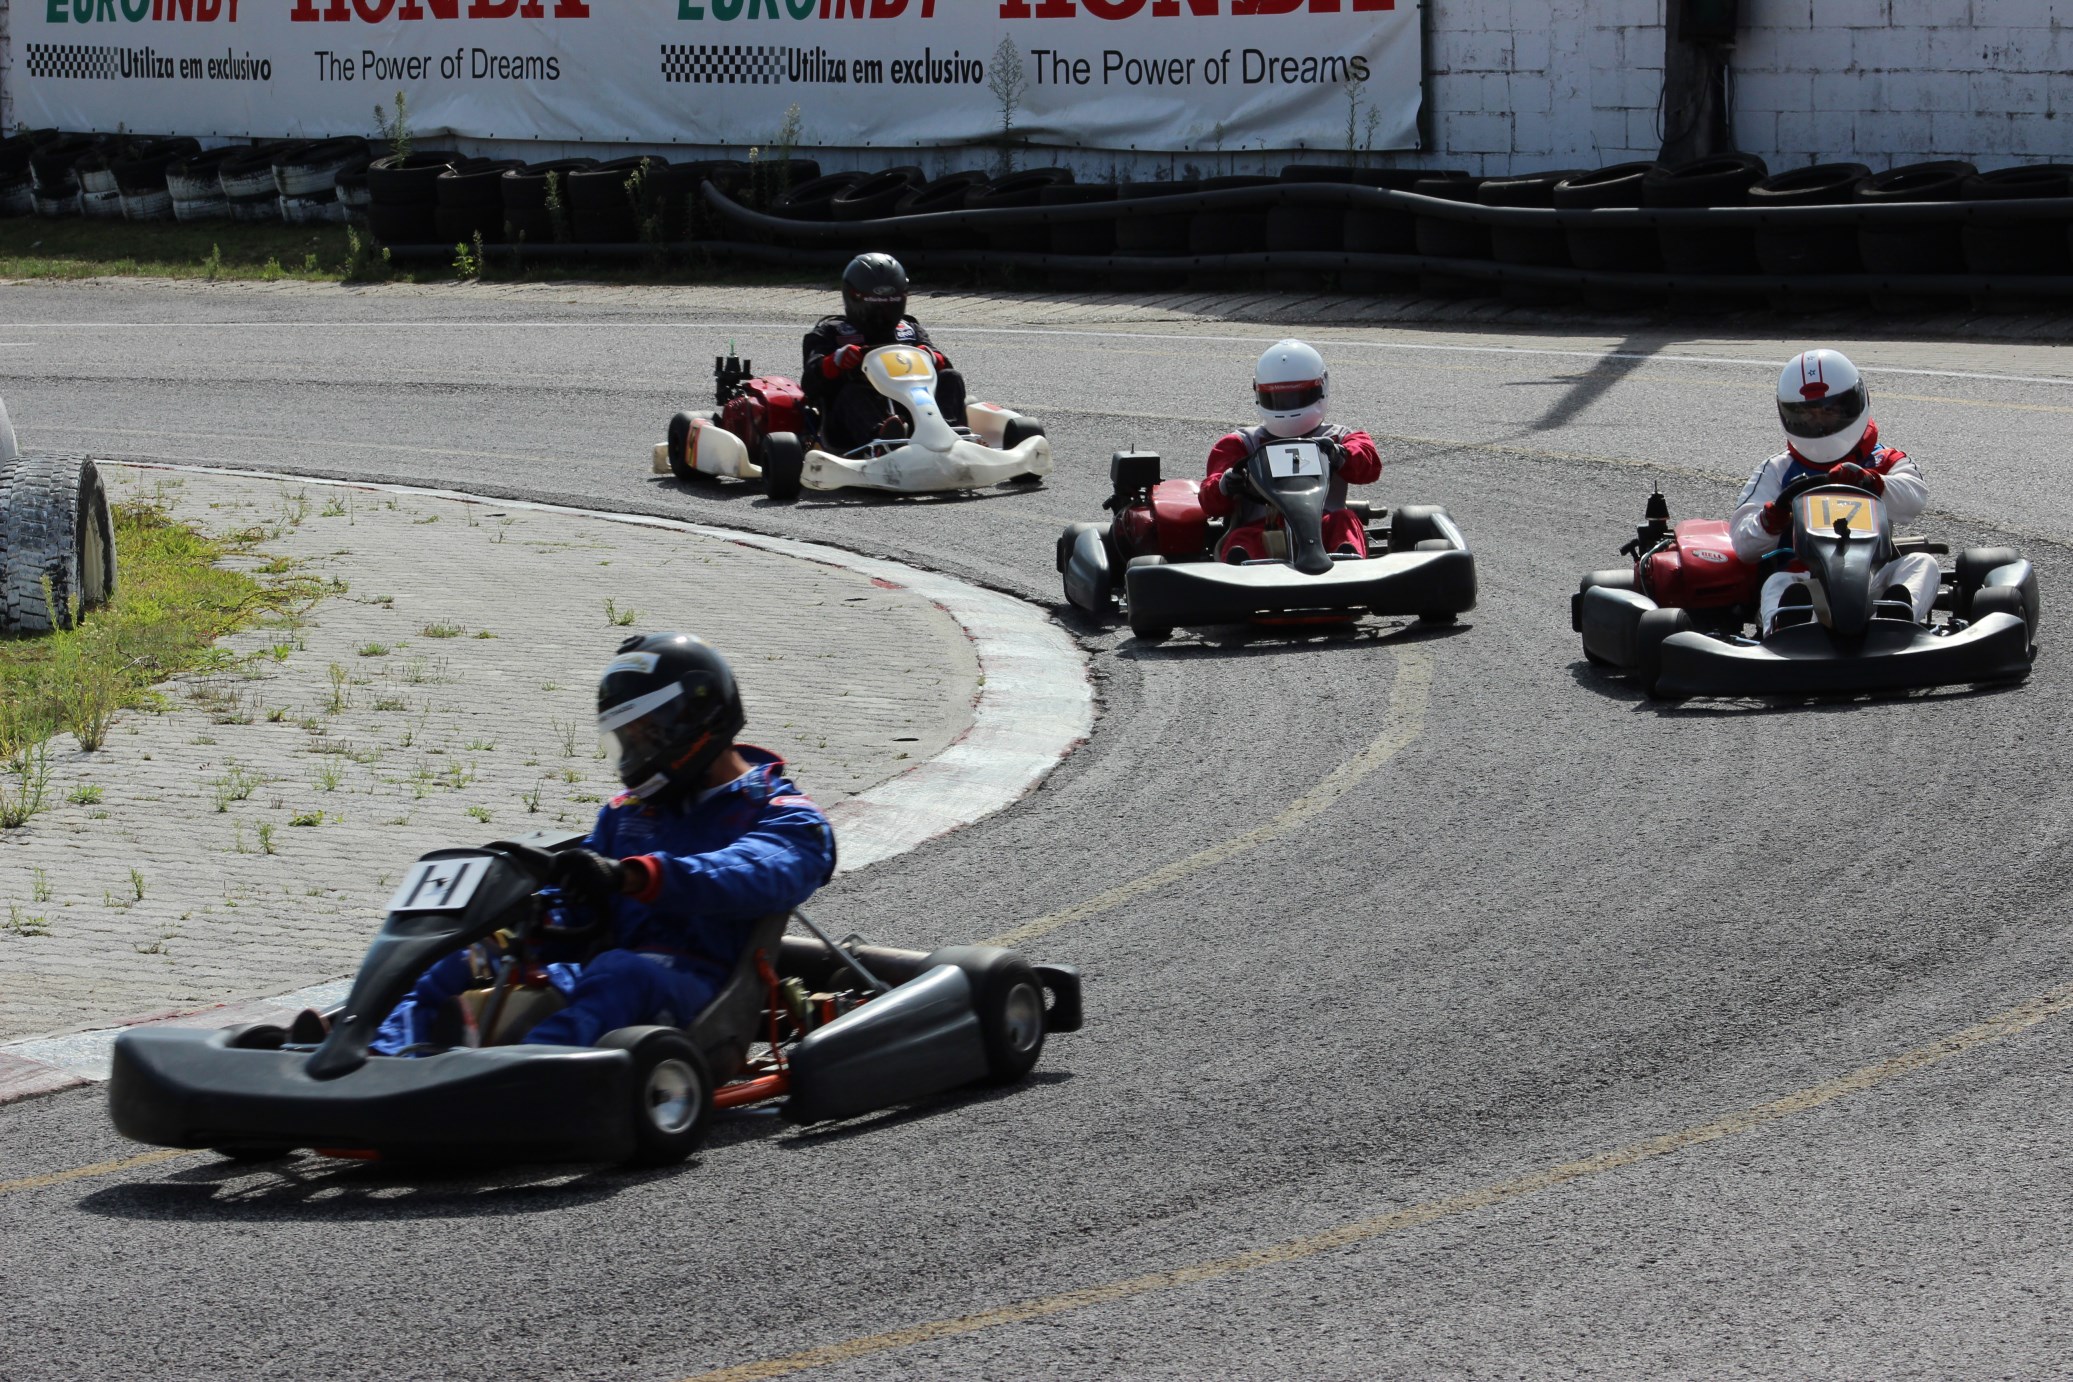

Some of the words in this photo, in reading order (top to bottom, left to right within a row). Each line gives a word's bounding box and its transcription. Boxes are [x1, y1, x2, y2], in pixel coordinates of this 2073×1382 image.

[119, 46, 174, 79] Utiliza
[179, 56, 203, 79] em
[207, 47, 272, 80] exclusivo
[314, 51, 355, 81] The
[362, 50, 432, 81] Power
[440, 48, 464, 80] of
[471, 48, 560, 81] Dreams
[787, 46, 847, 83] Utiliza
[853, 59, 883, 84] em
[890, 47, 984, 84] exclusivo
[1031, 50, 1091, 84] The
[1103, 50, 1195, 85] Power
[1204, 49, 1231, 84] of
[1242, 48, 1371, 85] Dreams
[1821, 500, 1862, 525] 17
